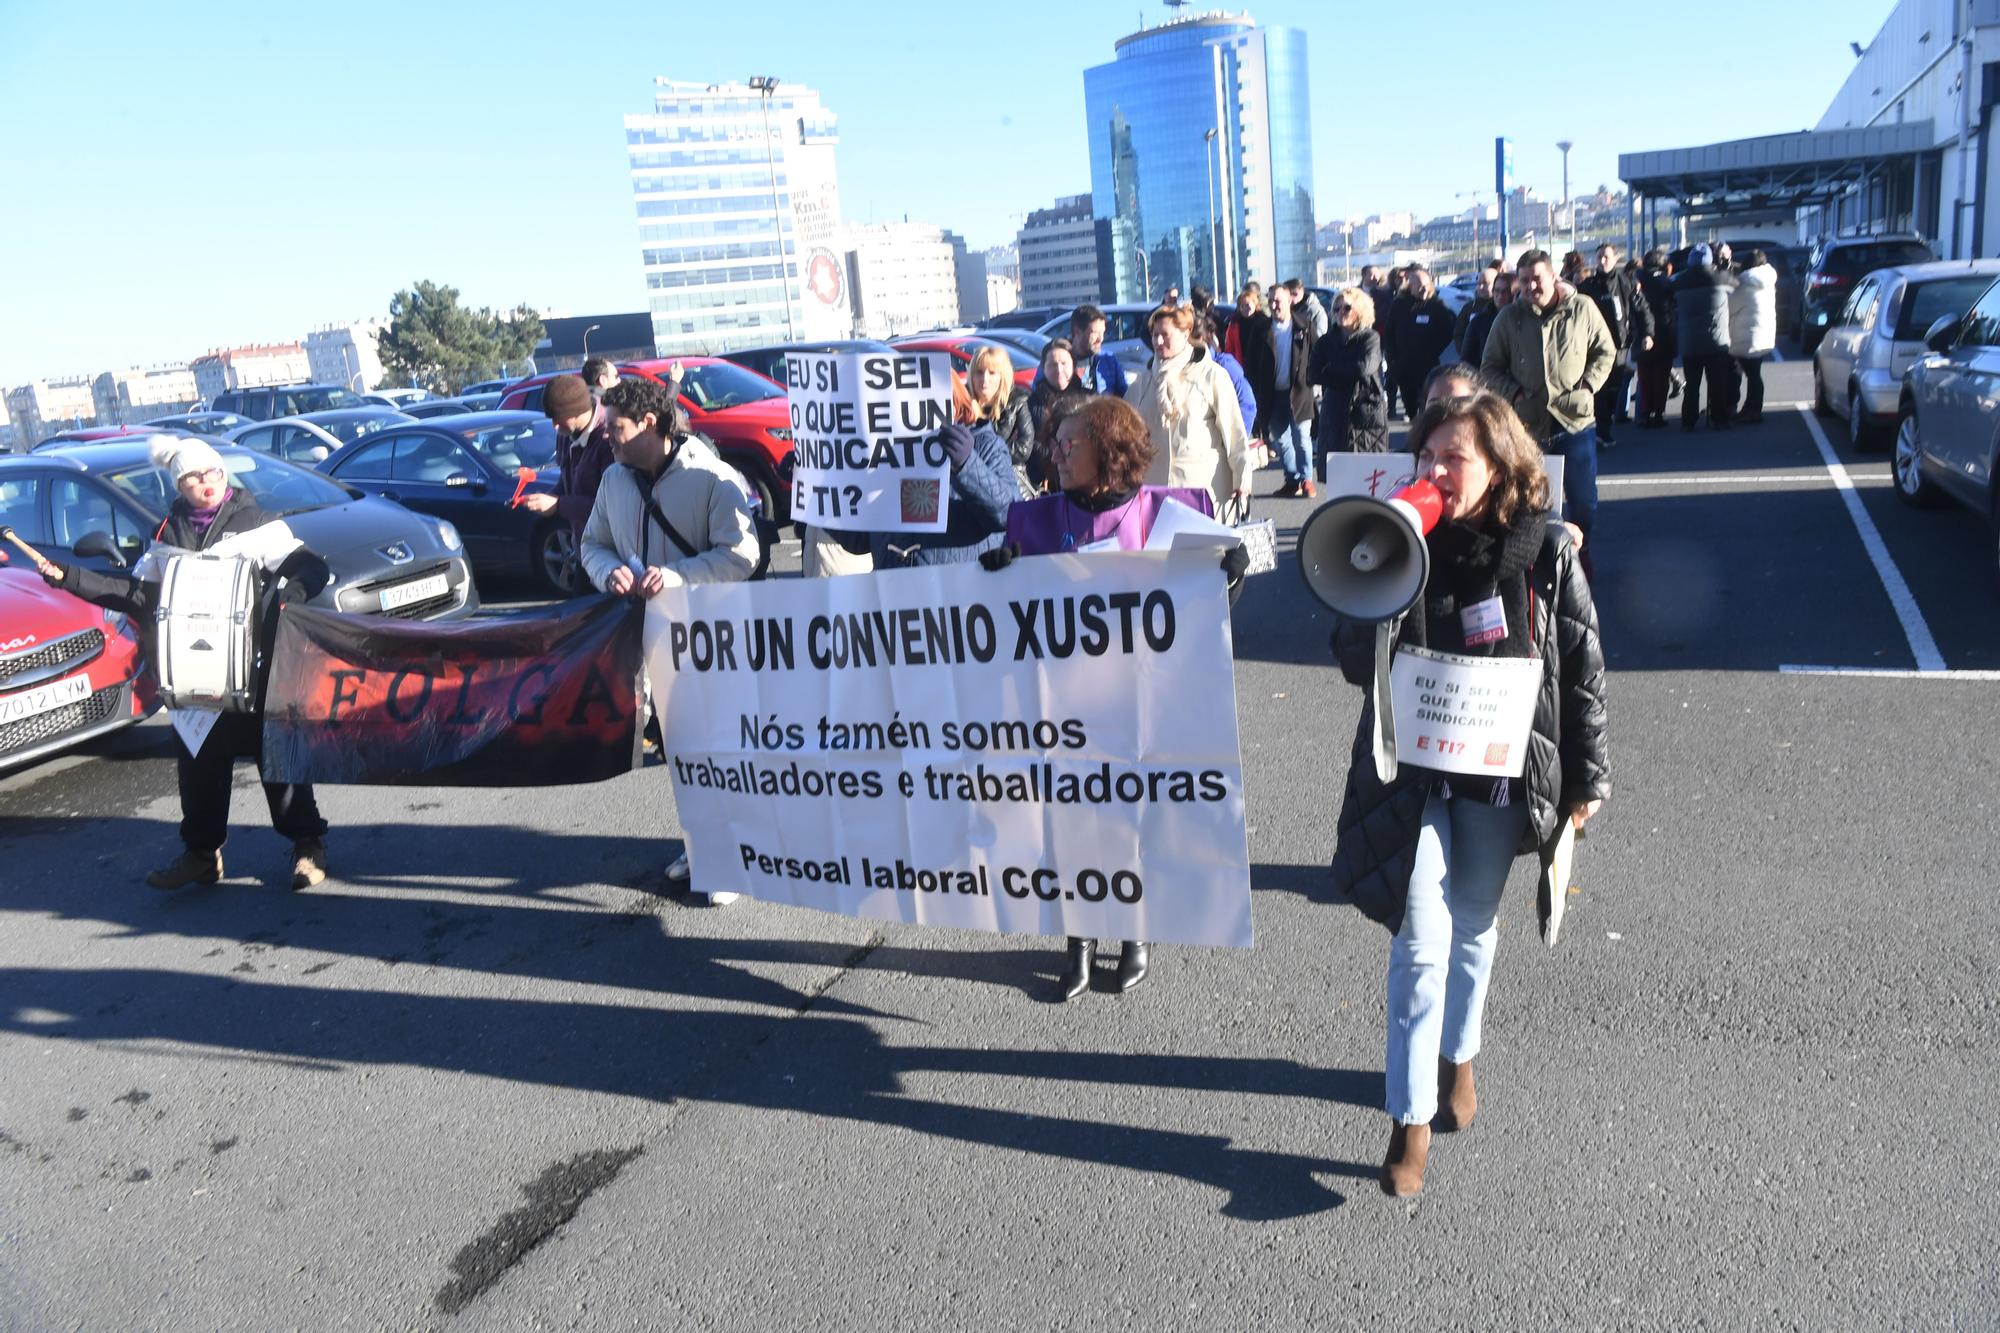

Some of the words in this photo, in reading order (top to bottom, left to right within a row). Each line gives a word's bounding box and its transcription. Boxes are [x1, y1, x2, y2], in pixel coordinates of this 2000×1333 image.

[786, 358, 810, 390] EU
[816, 360, 838, 392] SI
[864, 357, 931, 390] SEI
[791, 404, 800, 430] O
[805, 400, 856, 434] QUE
[867, 402, 892, 433] E
[901, 398, 952, 431] UN
[793, 436, 950, 470] SINDICATO
[796, 480, 805, 510] E
[813, 485, 863, 517] TI?
[670, 619, 738, 672] POR
[744, 617, 795, 672] UN
[807, 603, 997, 670] CONVENIO
[1008, 589, 1176, 661] XUSTO
[0, 691, 47, 719] 7012
[52, 679, 87, 703] LYM
[324, 662, 625, 728] FOLGA
[1415, 676, 1437, 690] EU
[1445, 683, 1460, 694] SI
[1419, 694, 1452, 709] QUE
[740, 714, 805, 750] Nós
[817, 711, 931, 750] tamén
[941, 718, 1087, 751] somos
[1416, 708, 1495, 728] SINDICATO
[1416, 735, 1430, 751] E
[1437, 738, 1466, 755] TI?
[674, 755, 883, 798] traballadores
[898, 769, 914, 798] e
[924, 762, 1227, 803] traballadoras
[739, 843, 851, 885] Persoal
[862, 857, 988, 896] laboral
[1001, 866, 1144, 904] CC.OO
